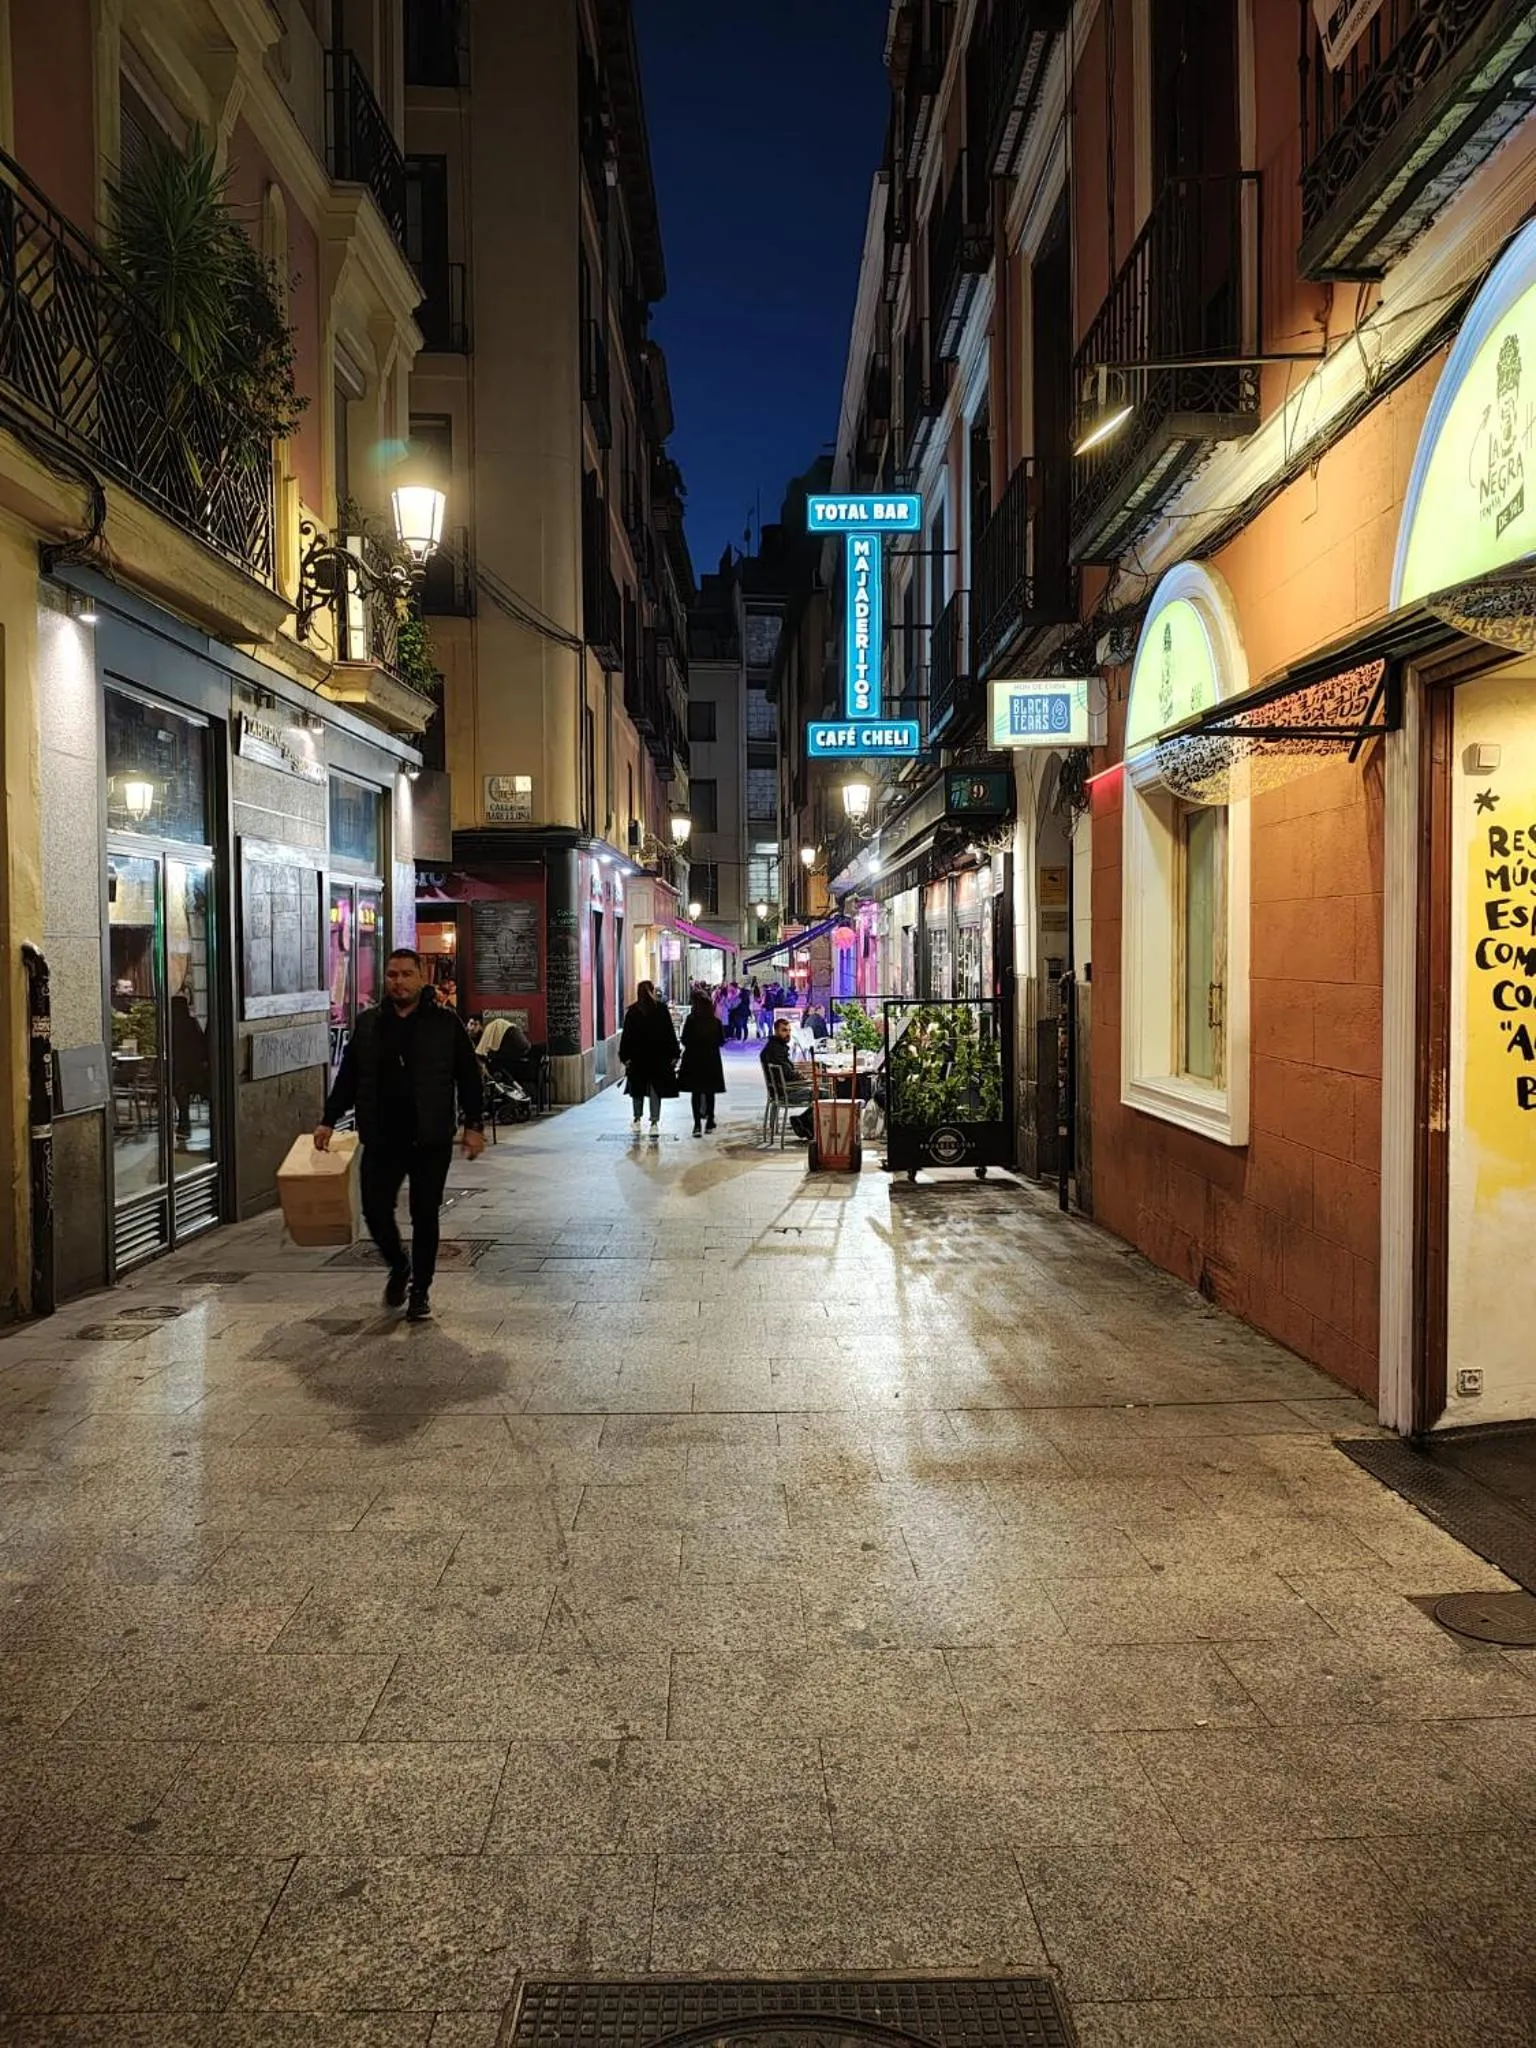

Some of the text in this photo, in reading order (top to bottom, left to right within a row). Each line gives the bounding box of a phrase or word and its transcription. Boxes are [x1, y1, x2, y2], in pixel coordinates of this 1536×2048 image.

[1479, 450, 1524, 503] NEGRA
[815, 503, 909, 520] TOTAL BAR
[854, 541, 870, 710] MAJADERITOS
[1013, 698, 1050, 715] BLACK
[1013, 715, 1050, 731] TEARS
[815, 727, 909, 747] CAFÉ CHELI
